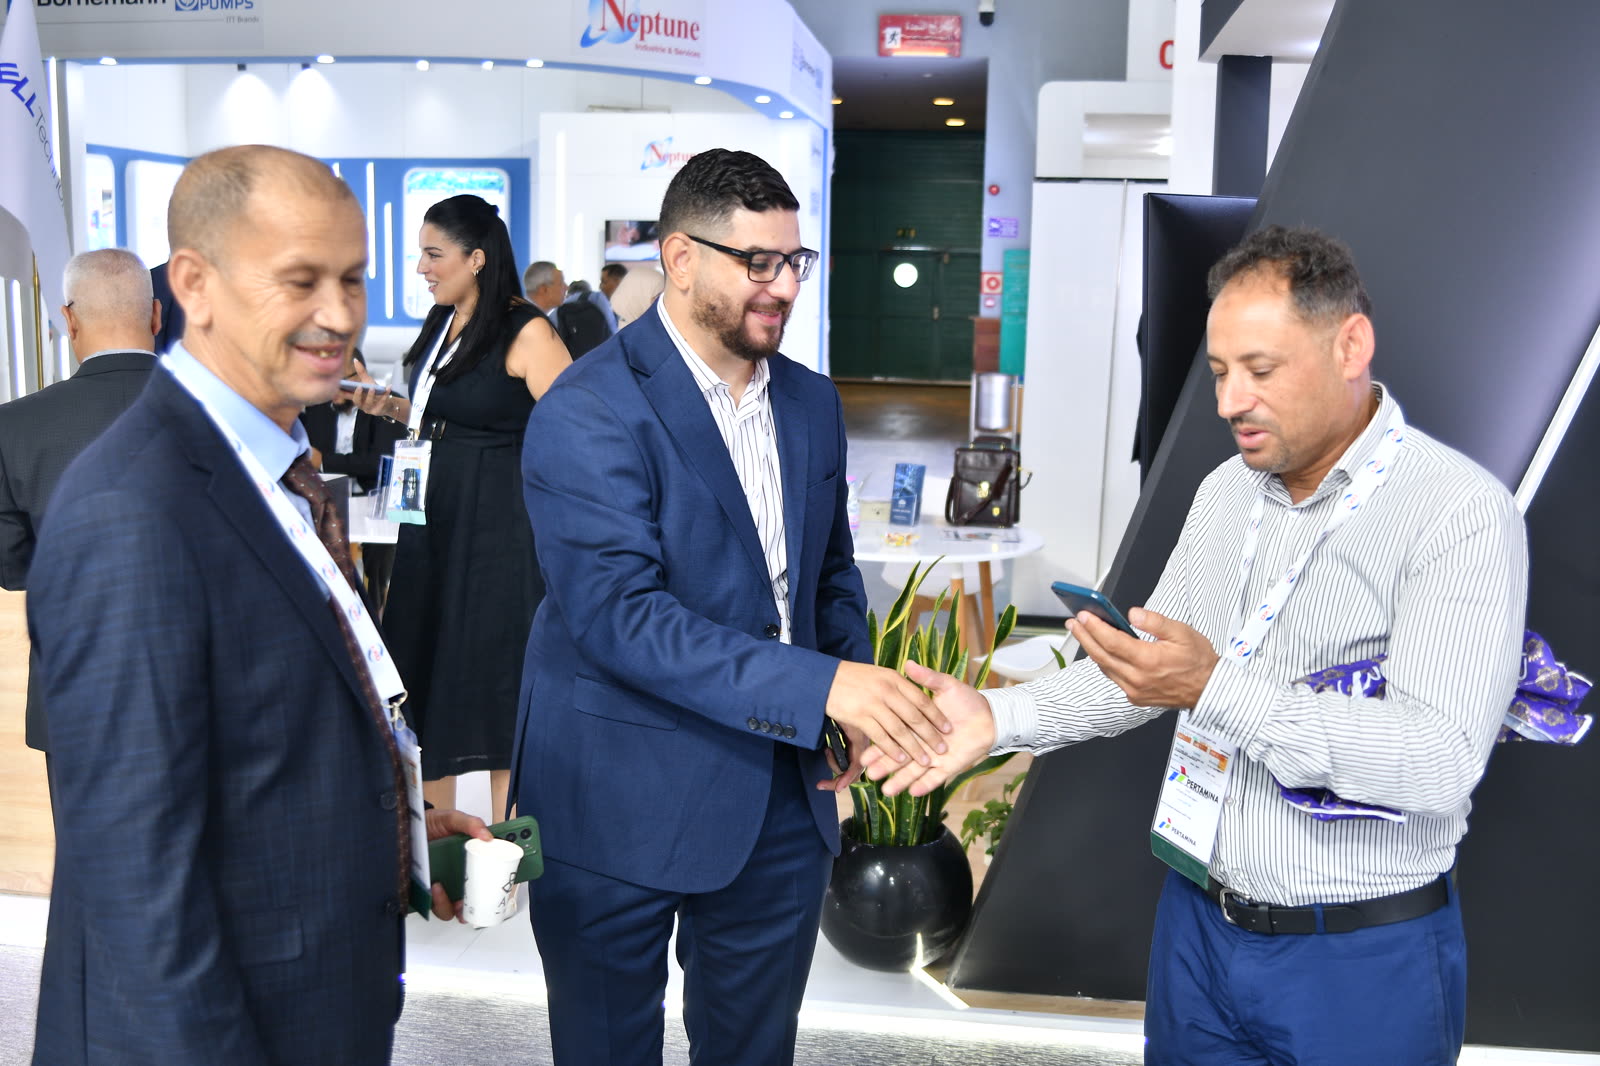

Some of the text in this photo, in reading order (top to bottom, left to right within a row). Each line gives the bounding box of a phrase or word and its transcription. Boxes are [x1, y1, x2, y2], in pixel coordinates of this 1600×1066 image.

[200, 0, 254, 10] PUMPS
[599, 0, 700, 41] Neptune
[1186, 778, 1219, 804] PERTAMINA
[1171, 826, 1197, 846] PERTAMINA
